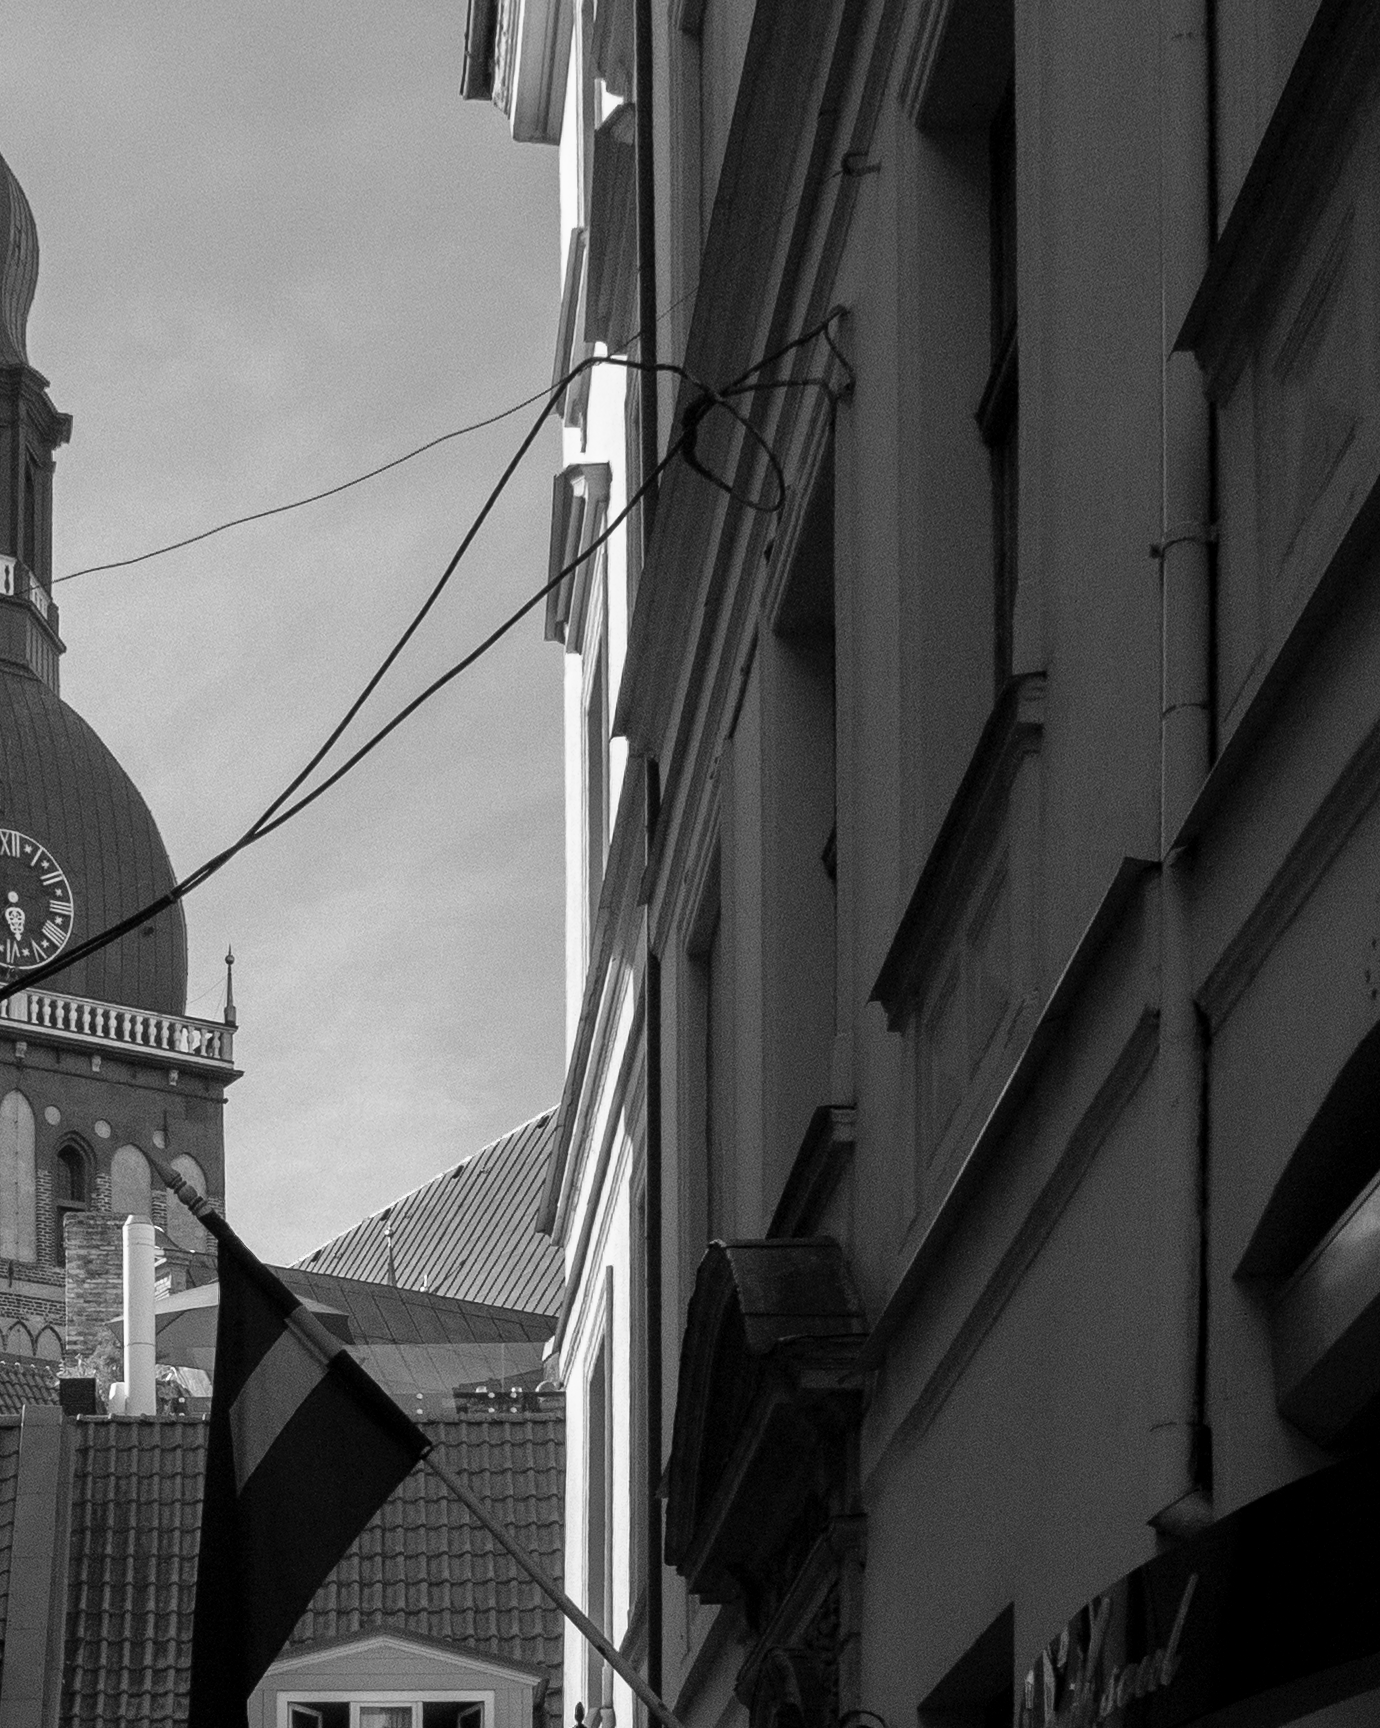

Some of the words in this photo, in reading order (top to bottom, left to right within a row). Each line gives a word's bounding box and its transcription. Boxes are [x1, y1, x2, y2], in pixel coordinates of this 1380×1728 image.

[0, 830, 20, 857] XII
[40, 871, 64, 886] II
[49, 899, 72, 915] III
[6, 938, 20, 963] VI
[30, 937, 47, 963] V
